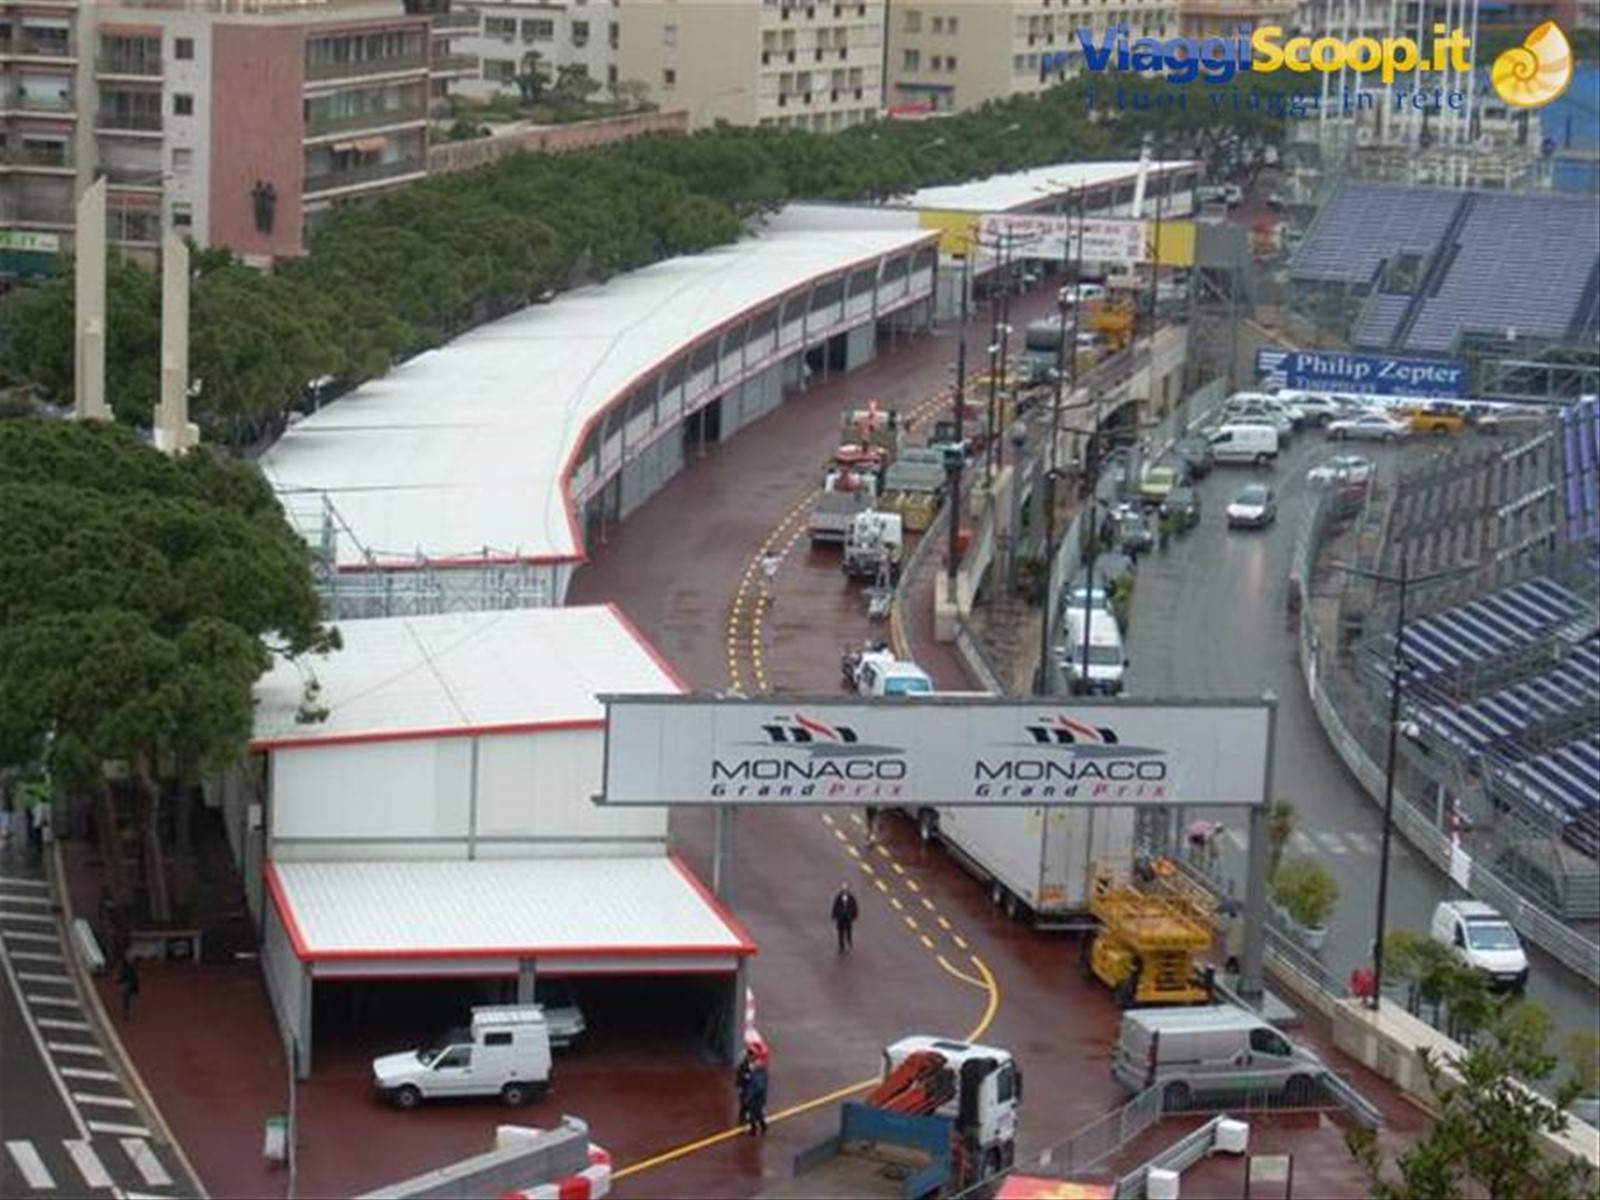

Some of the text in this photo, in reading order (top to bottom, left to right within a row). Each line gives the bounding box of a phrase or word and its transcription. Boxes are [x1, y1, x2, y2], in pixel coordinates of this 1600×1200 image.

[1296, 353, 1461, 384] Philip Zepter
[711, 759, 907, 780] MONACO
[974, 760, 1167, 780] MONACO
[711, 783, 904, 797] Grand Prix
[975, 783, 1167, 797] Grand Prix
